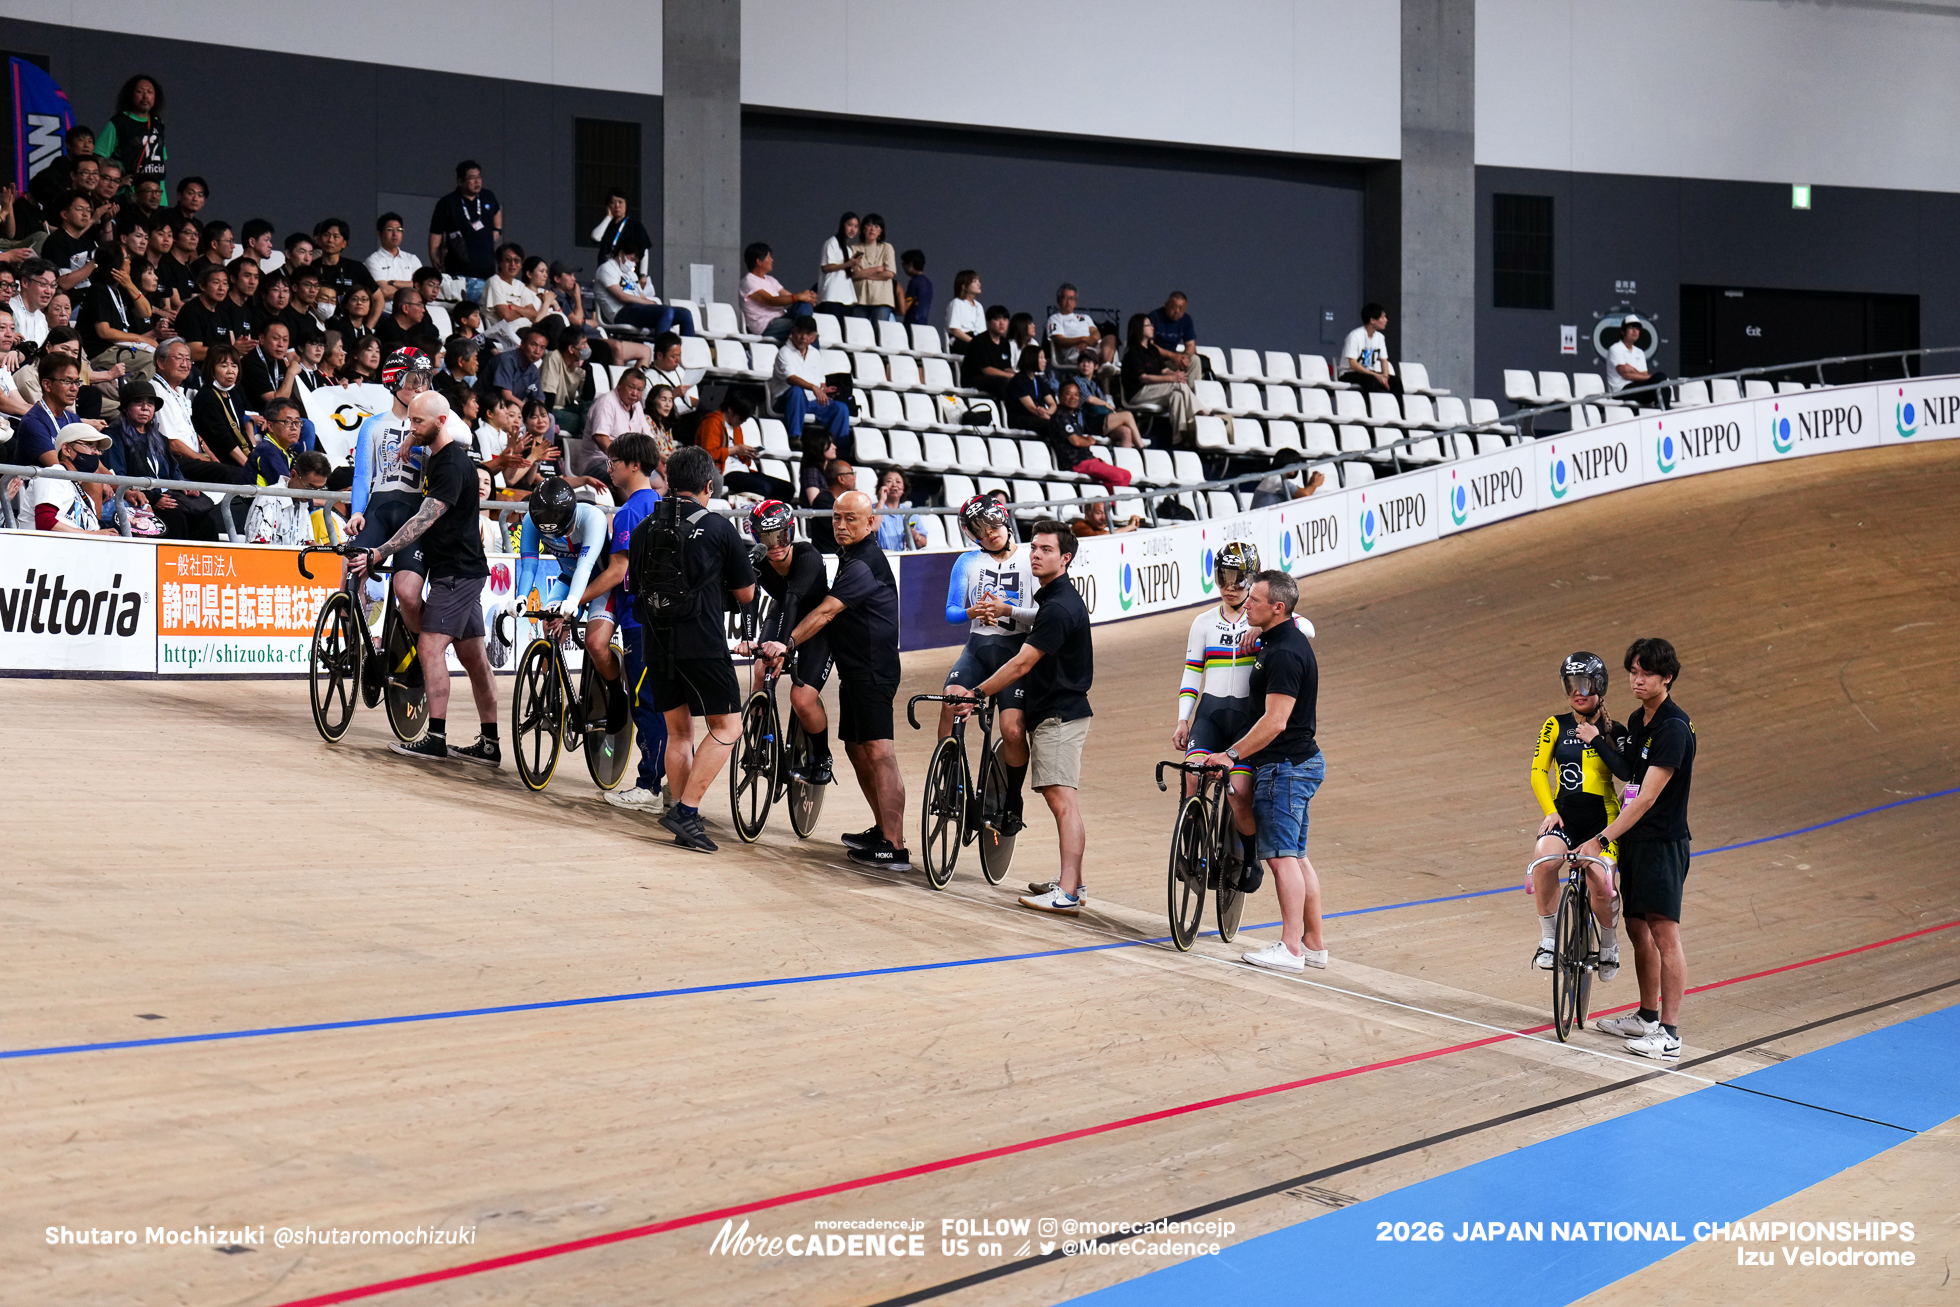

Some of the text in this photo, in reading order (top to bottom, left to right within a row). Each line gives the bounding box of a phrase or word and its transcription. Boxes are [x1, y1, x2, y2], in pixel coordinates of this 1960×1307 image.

[1746, 325, 1762, 337] Exit
[1680, 422, 1741, 460] NIPPO
[1798, 405, 1863, 441] NIPPO
[1572, 442, 1627, 484] NIPPO
[1471, 466, 1523, 511] NIPPO
[1379, 493, 1426, 537] NIPPO
[1296, 514, 1338, 558] NIPPO
[165, 553, 237, 578] 一般社団法人
[1137, 560, 1180, 606] NIPPO
[1542, 719, 1555, 744] UNIV
[874, 851, 894, 859] HOKA
